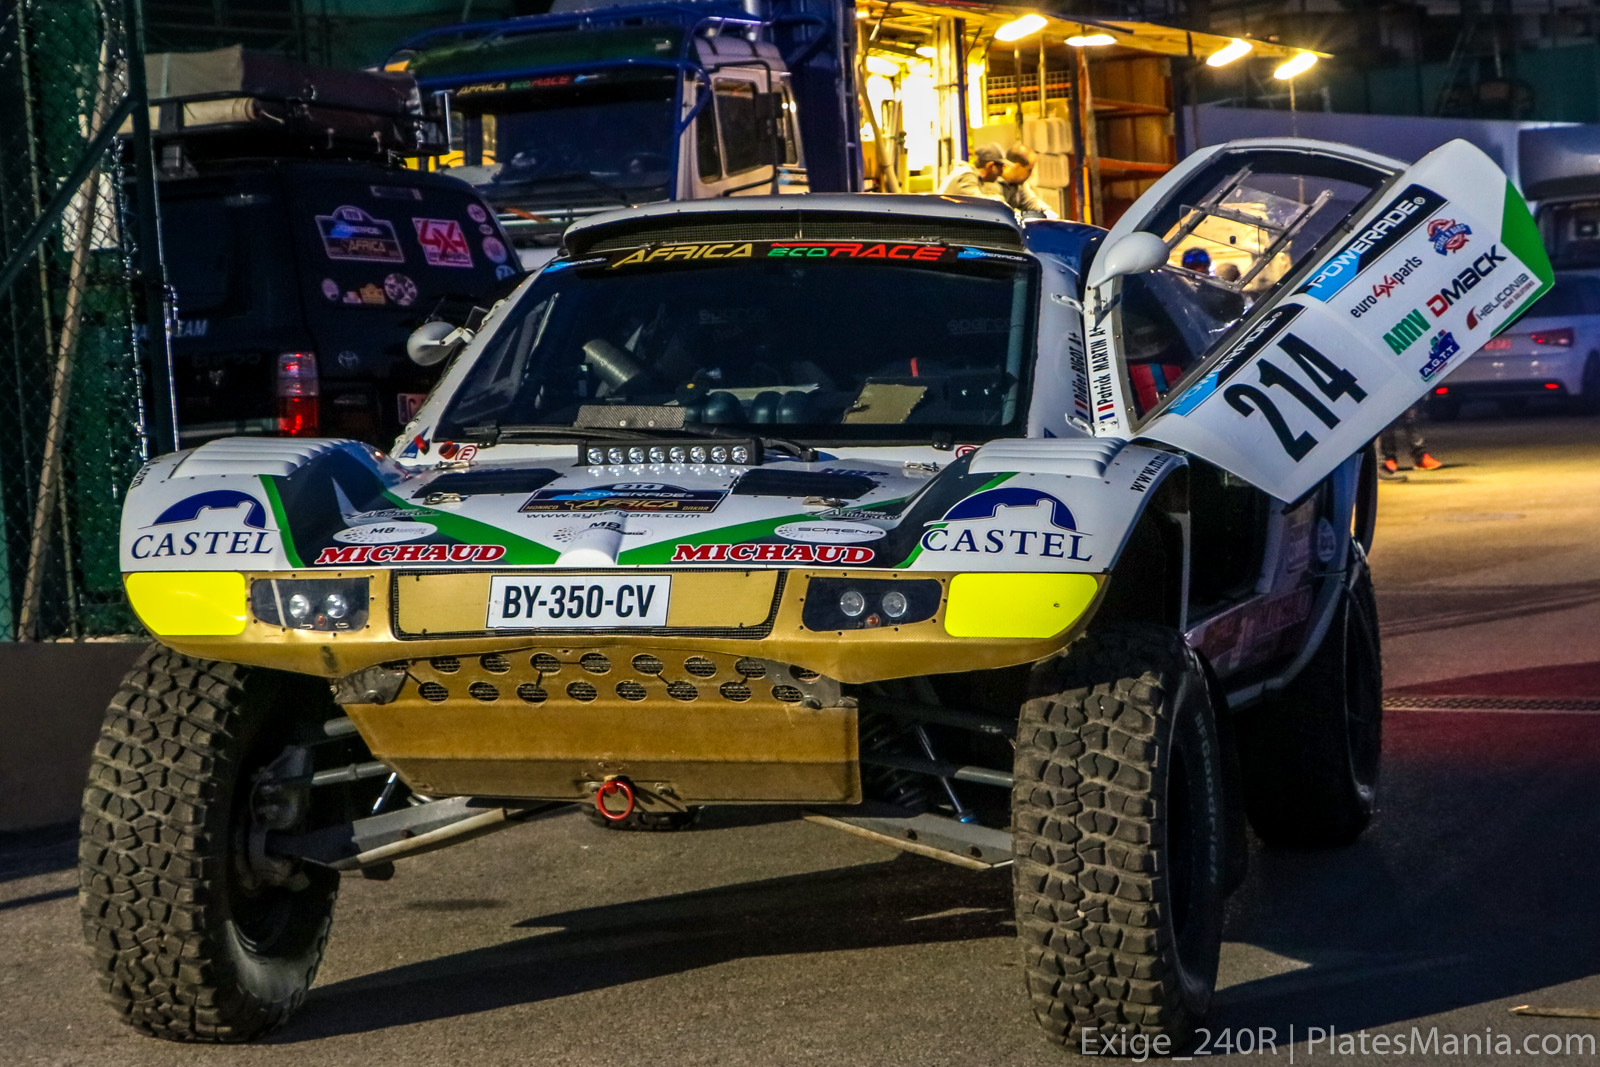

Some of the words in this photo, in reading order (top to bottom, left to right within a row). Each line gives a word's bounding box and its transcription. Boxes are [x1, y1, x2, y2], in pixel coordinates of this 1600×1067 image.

[612, 243, 753, 268] AFRICA
[1307, 199, 1420, 288] POWERADE
[1090, 338, 1110, 373] MARTIN
[1093, 373, 1114, 406] Patrick
[1223, 332, 1368, 463] 214
[578, 500, 679, 509] AFRICA
[589, 521, 622, 529] MB
[797, 527, 884, 535] SORENA
[131, 532, 274, 560] CASTEL
[315, 544, 506, 564] MICHAUD
[672, 543, 875, 564] MICHAUD
[921, 529, 1093, 562] CASTEL
[502, 584, 656, 619] BY-350-CV
